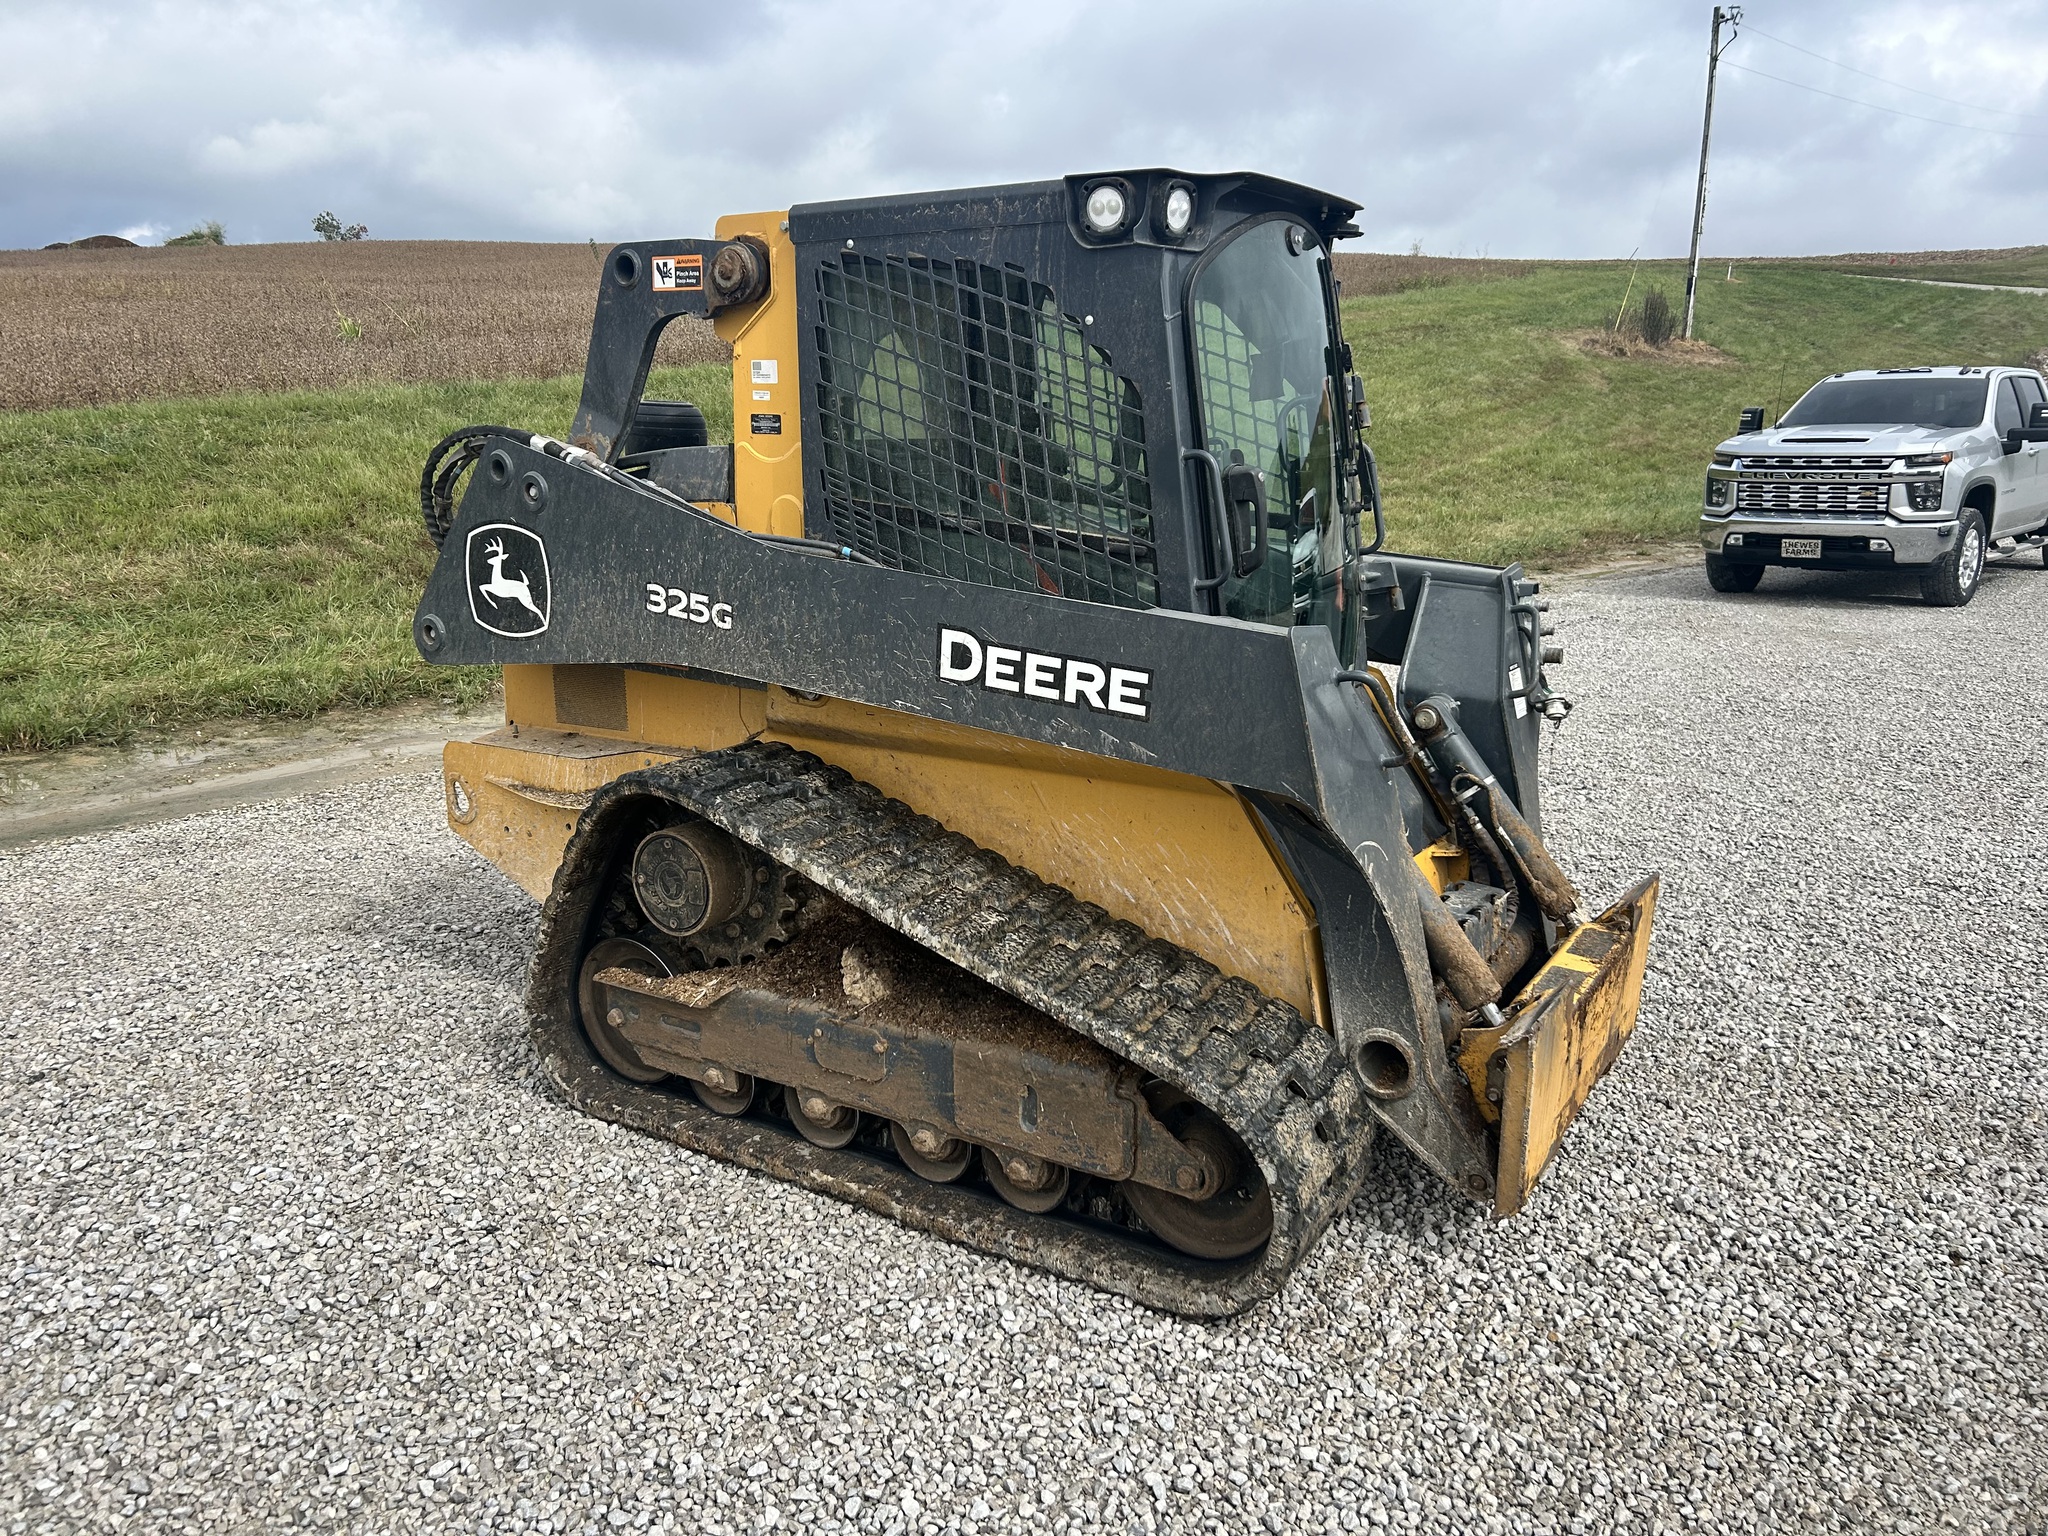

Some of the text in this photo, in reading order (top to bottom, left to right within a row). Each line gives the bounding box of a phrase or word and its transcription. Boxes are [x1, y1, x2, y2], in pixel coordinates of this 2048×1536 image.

[1738, 470, 1894, 481] CHEVROLET
[1783, 541, 1819, 549] THEWES
[646, 583, 733, 630] 325G
[938, 627, 1150, 717] DEERE
